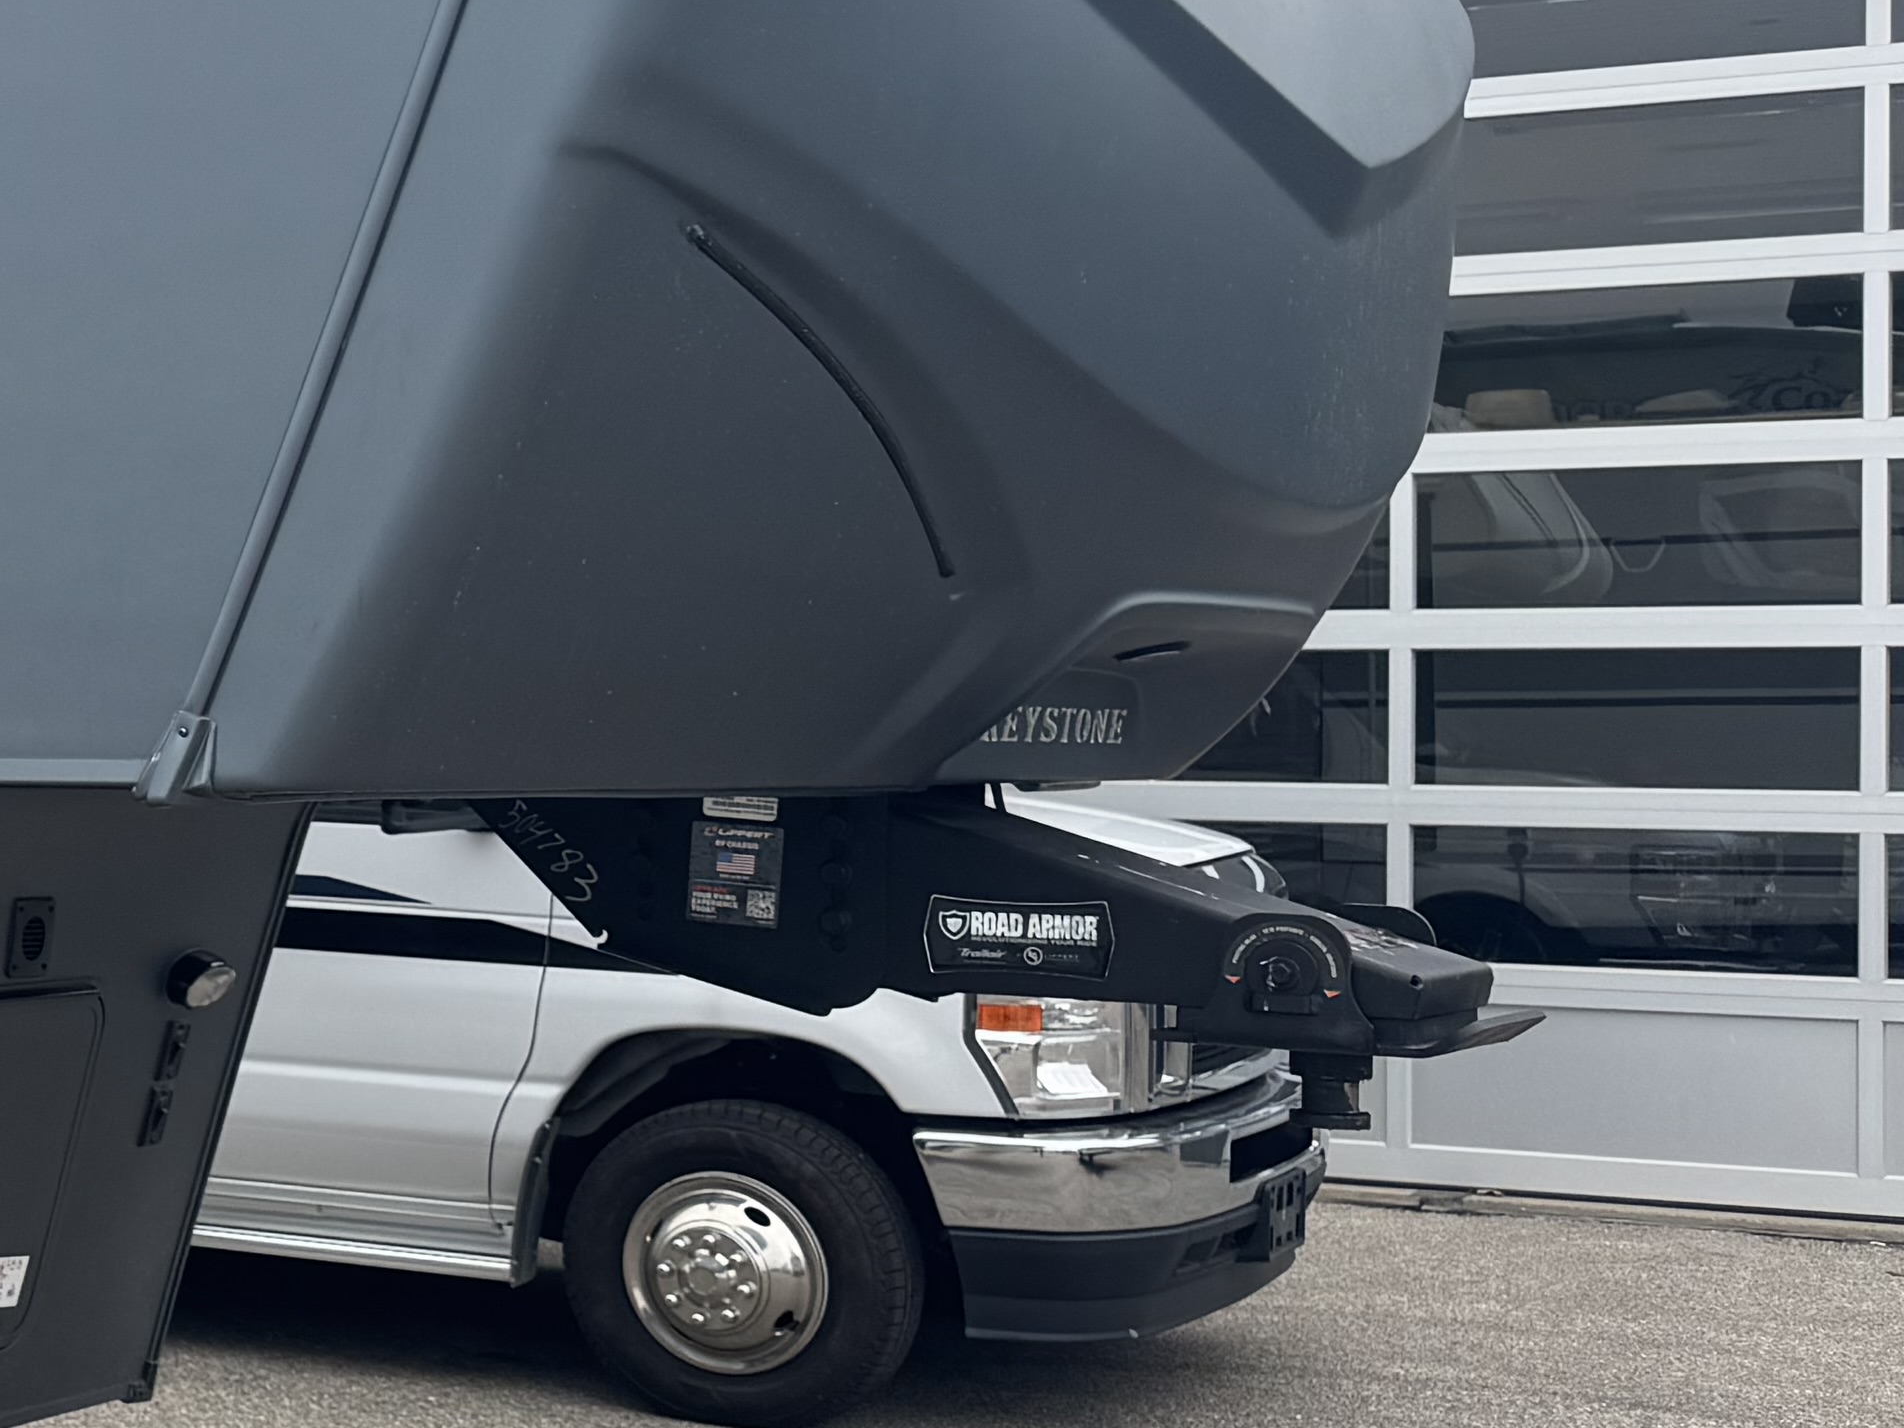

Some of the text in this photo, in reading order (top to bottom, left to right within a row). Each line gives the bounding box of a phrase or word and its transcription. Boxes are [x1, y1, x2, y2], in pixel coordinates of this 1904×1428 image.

[497, 798, 599, 902] 504783
[970, 910, 1098, 942] ROAD ARMOR
